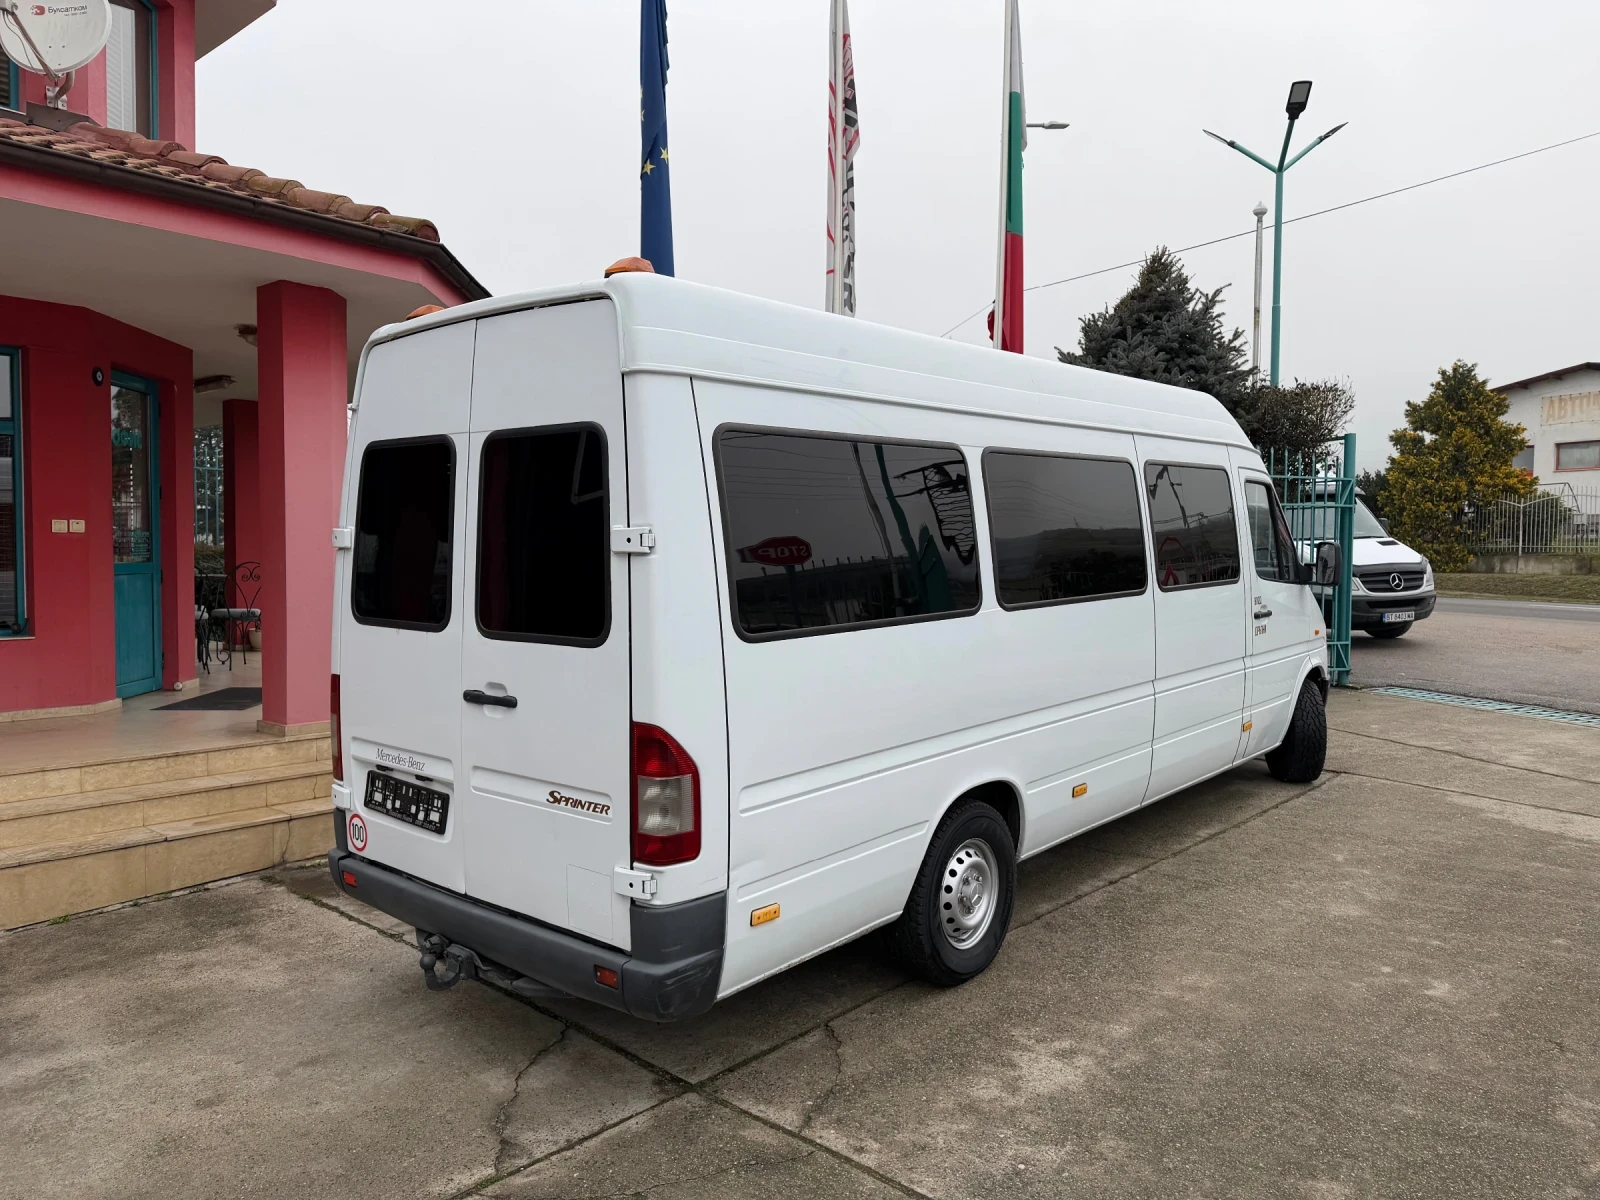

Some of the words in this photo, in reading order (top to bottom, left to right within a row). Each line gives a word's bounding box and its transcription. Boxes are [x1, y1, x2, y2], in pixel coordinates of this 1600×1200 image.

[375, 747, 426, 772] Mercedes-Benz
[545, 790, 611, 816] SPRINTER
[351, 822, 364, 843] 100
